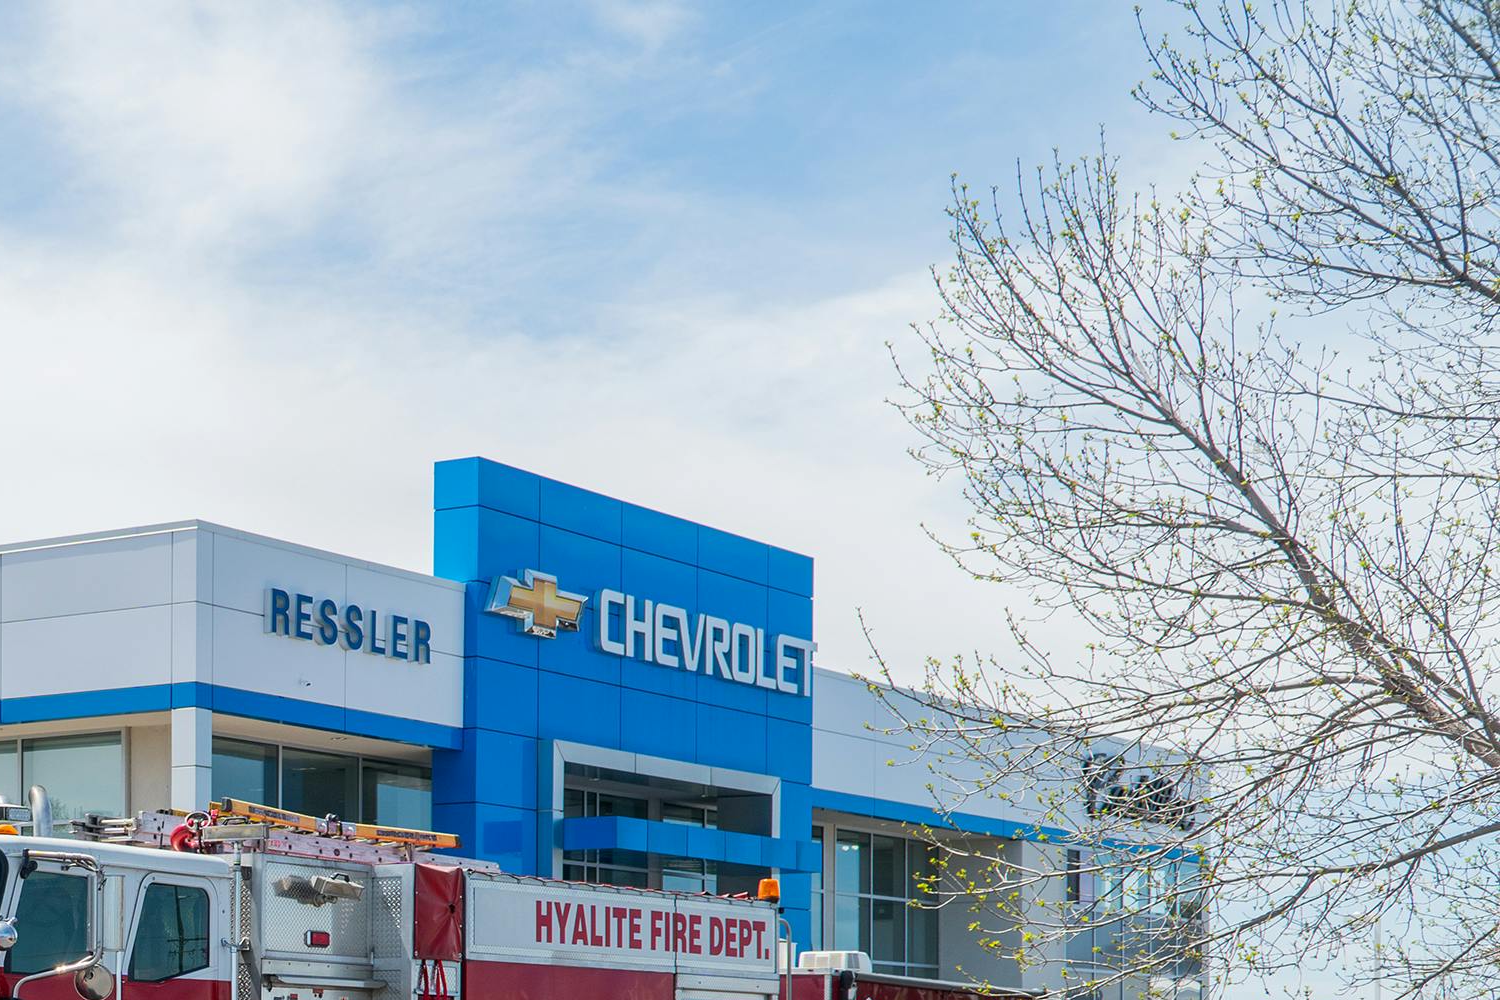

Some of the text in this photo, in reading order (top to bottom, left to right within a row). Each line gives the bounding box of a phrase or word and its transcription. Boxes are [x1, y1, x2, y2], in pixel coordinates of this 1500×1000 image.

[265, 587, 431, 665] RESSLER
[598, 587, 818, 697] CHEVROLET
[535, 899, 770, 960] HYALITE FIRE DEPT.
